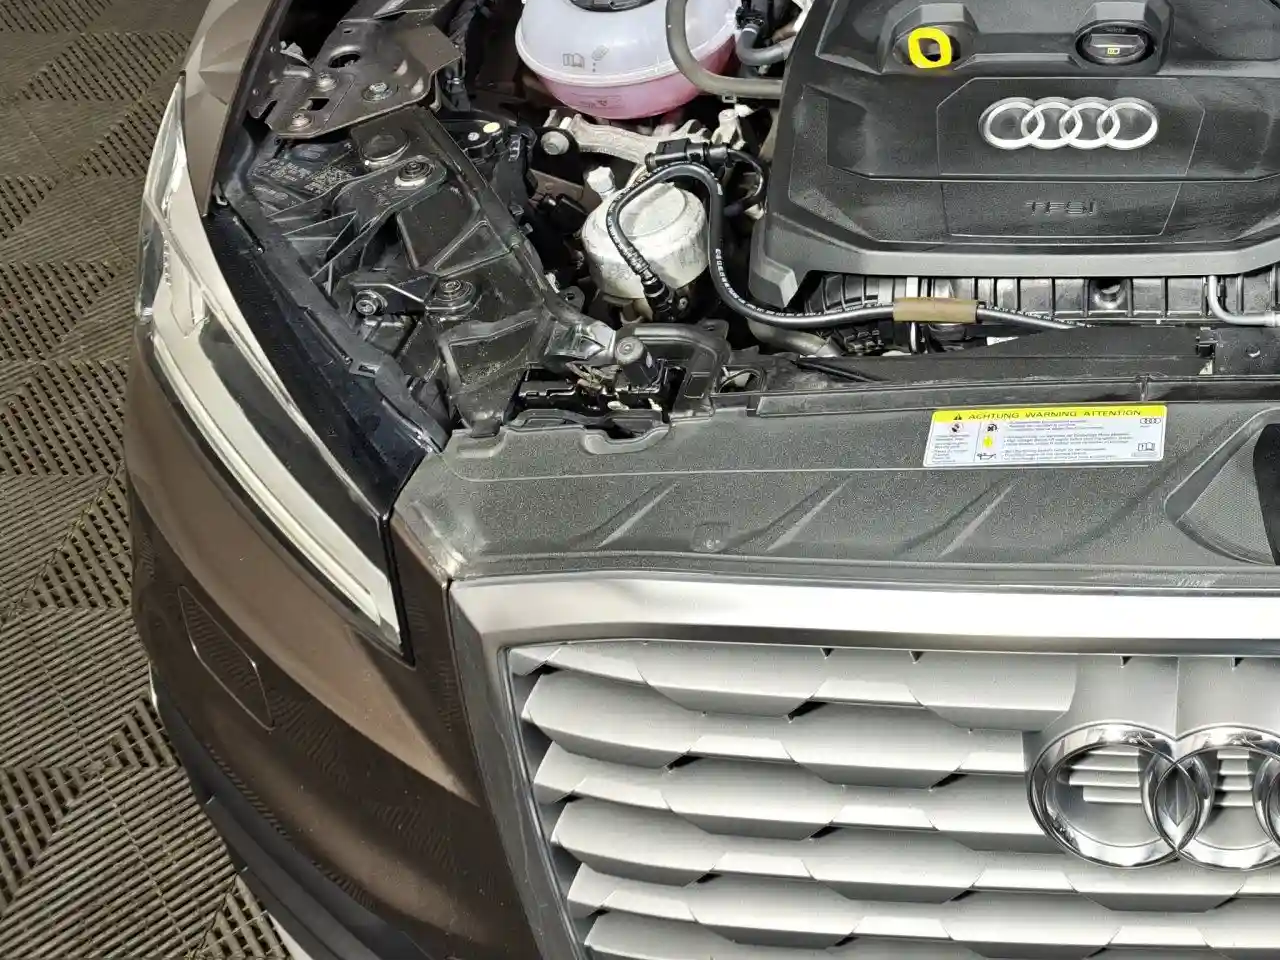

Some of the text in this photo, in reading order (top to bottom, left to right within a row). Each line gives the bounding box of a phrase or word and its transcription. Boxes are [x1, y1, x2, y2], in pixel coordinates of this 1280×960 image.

[1026, 201, 1096, 216] TFSI
[968, 409, 1142, 421] ACHTUNG WARNING ATTENTION
